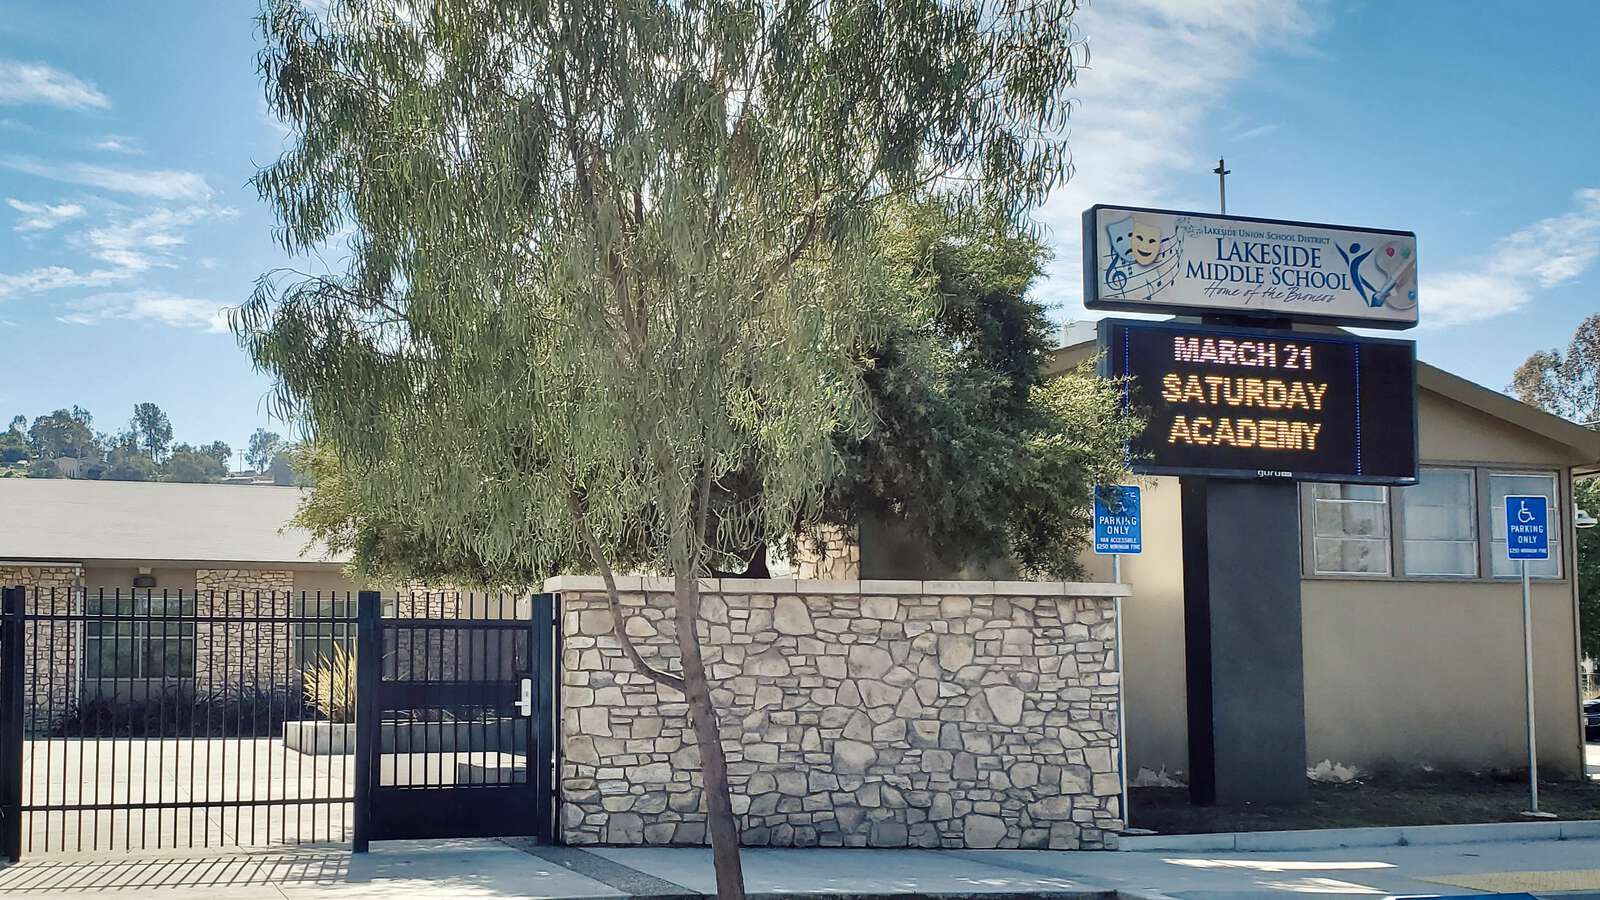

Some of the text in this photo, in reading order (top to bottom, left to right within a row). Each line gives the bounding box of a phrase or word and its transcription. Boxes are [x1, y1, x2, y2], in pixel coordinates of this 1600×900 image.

[1204, 225, 1331, 245] LAKESIDE UNION SCHOOL DISTRICT
[1216, 237, 1322, 268] LAKESIDE
[1185, 260, 1351, 291] MIDDLE SCHOOL
[1204, 280, 1241, 298] Home
[1243, 284, 1259, 304] of
[1262, 287, 1285, 299] the
[1174, 336, 1312, 370] MARCH 21
[1161, 373, 1328, 410] SATURDAY
[1167, 415, 1321, 450] ACADEMY
[1099, 516, 1137, 525] PARKING
[1107, 526, 1130, 535] ONLY
[1510, 525, 1544, 533] PARKING
[1518, 535, 1537, 544] ONLY
